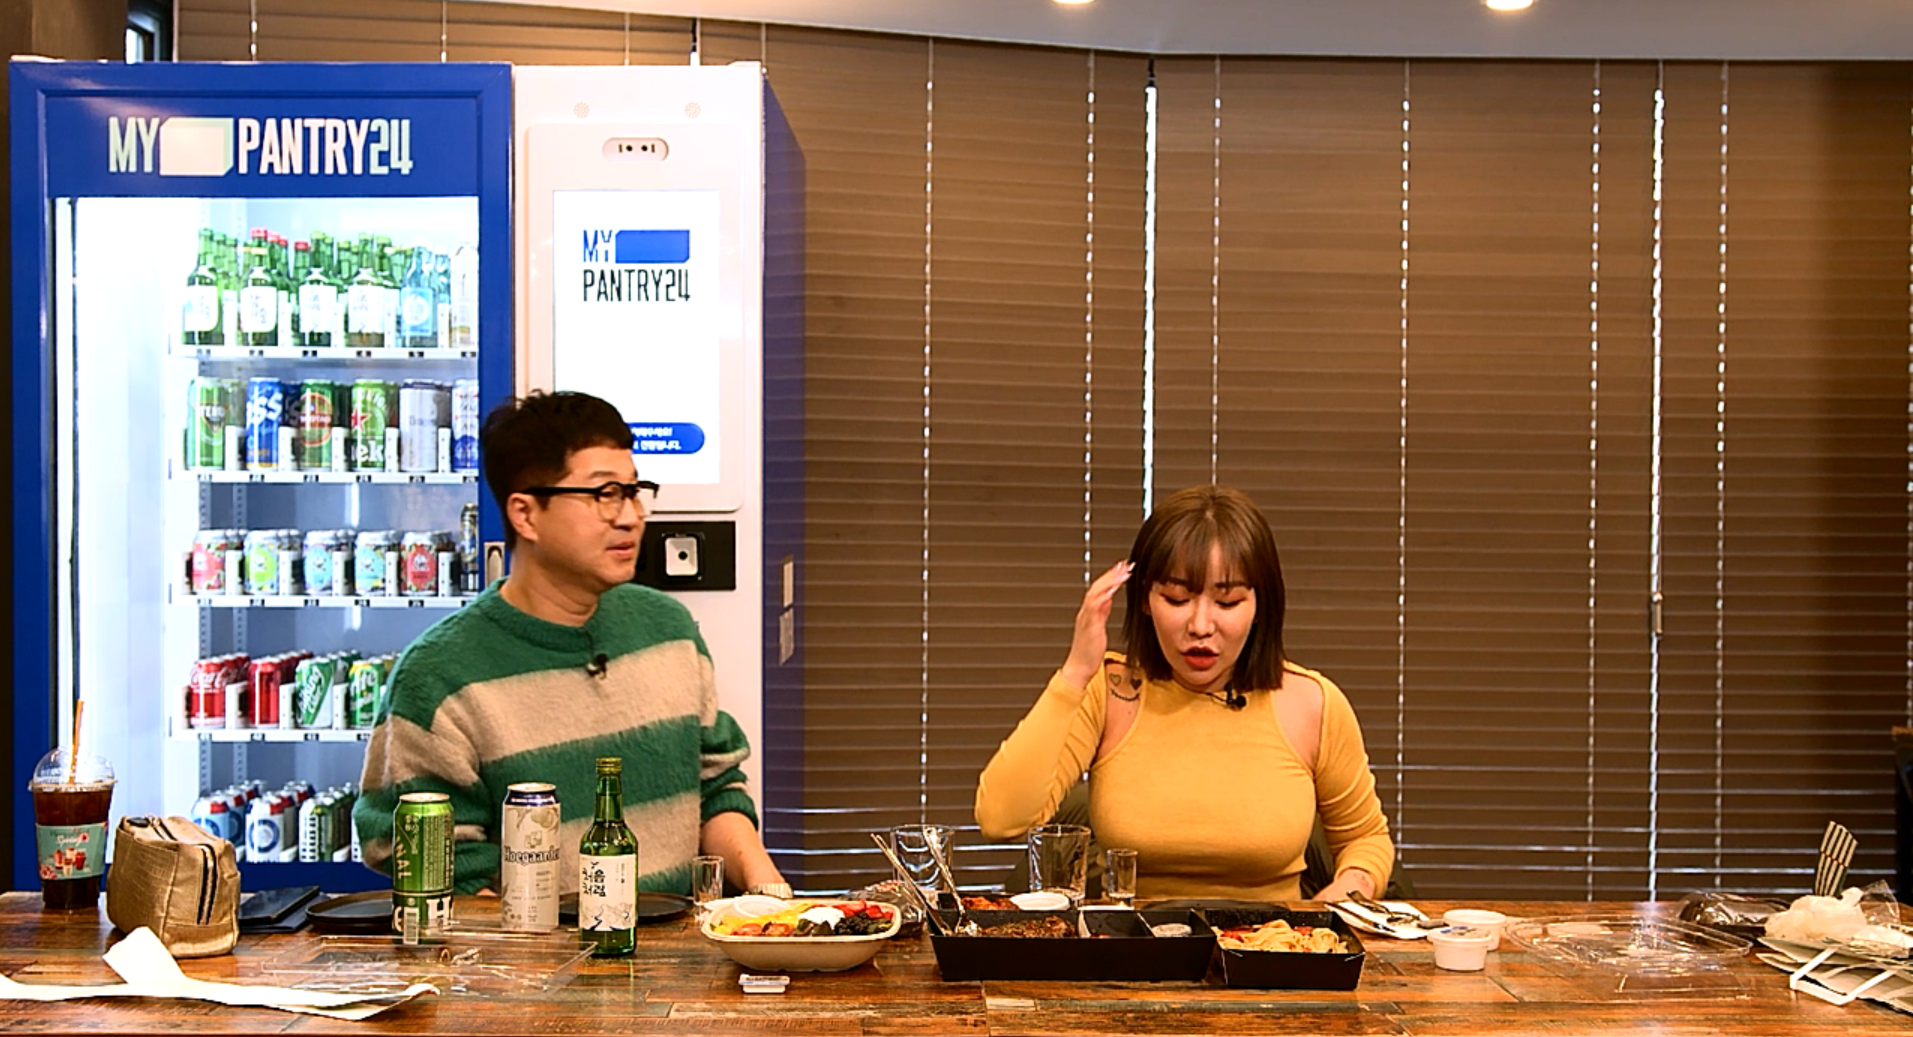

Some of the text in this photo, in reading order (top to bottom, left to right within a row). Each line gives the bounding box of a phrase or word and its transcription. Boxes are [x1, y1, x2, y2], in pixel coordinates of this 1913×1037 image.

[109, 117, 413, 175] MY PANTRY24
[583, 229, 613, 262] MY
[583, 269, 691, 302] PANTRY24
